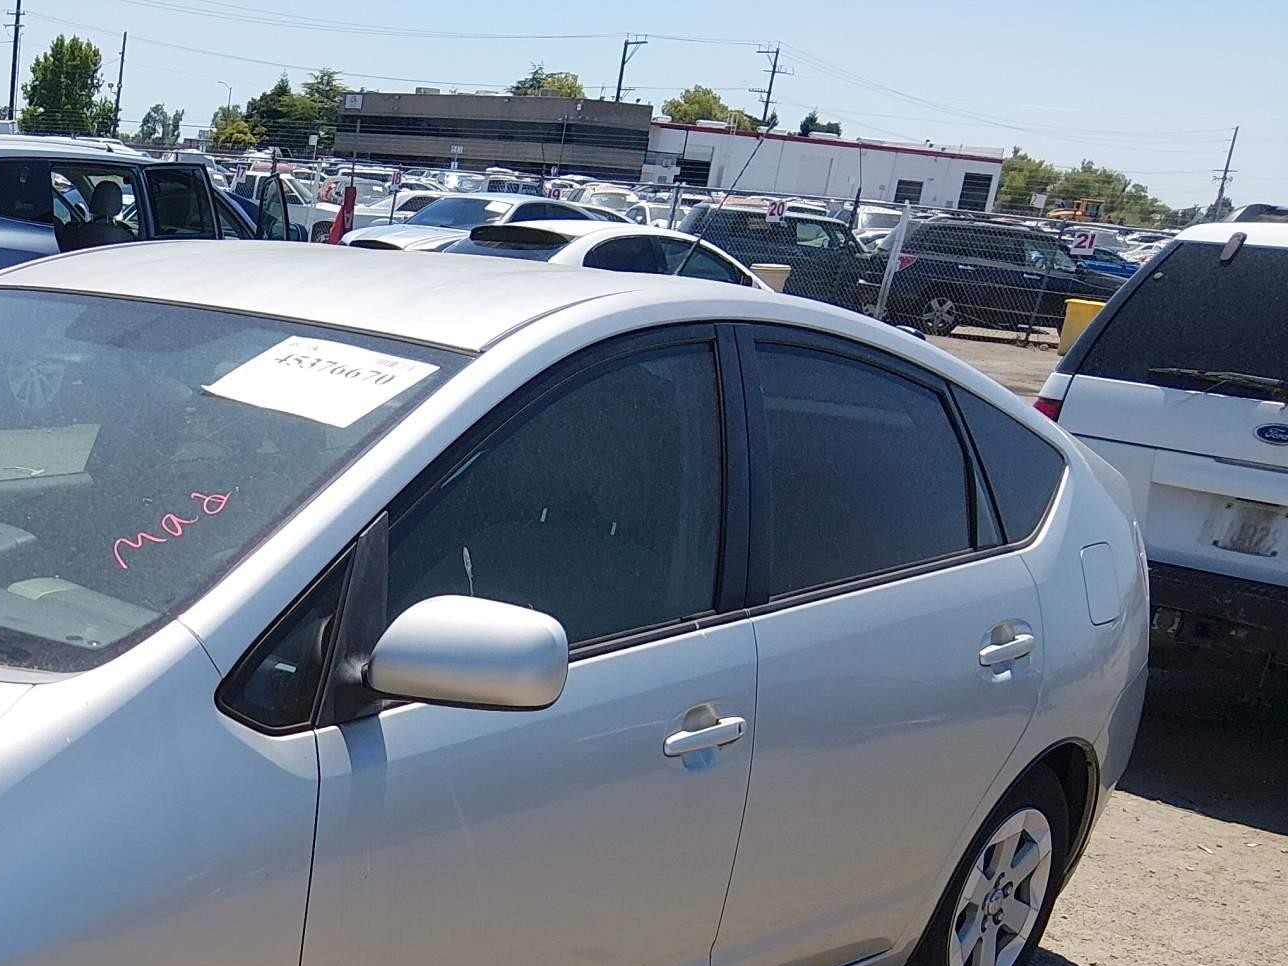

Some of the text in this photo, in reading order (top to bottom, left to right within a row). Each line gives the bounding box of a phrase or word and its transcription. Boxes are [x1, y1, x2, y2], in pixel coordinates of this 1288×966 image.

[236, 165, 247, 178] 17
[392, 171, 402, 186] 18
[547, 188, 561, 201] 19
[768, 201, 785, 217] 20
[1073, 233, 1096, 249] 21
[275, 353, 396, 386] 45376670
